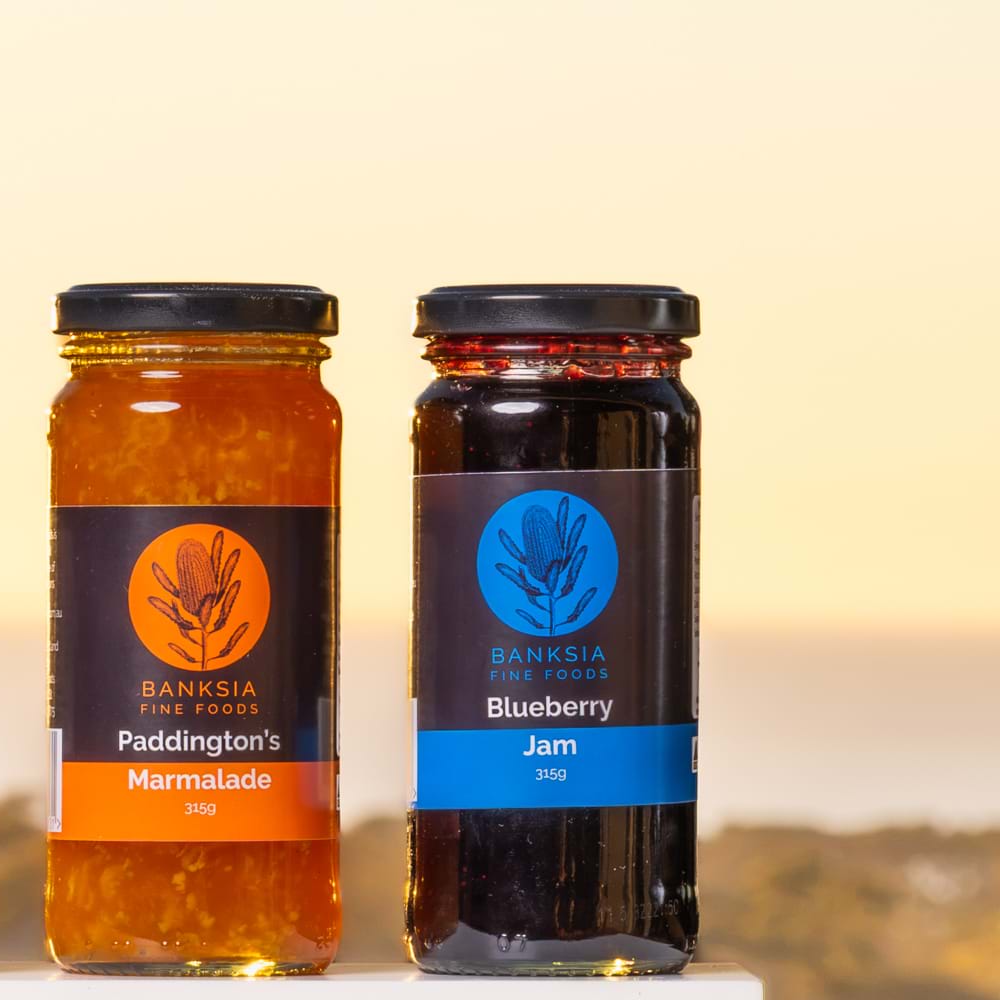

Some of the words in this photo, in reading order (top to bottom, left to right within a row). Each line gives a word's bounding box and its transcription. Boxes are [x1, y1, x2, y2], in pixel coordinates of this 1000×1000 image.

[491, 645, 606, 664] BANKSIA
[490, 669, 533, 680] FINE
[544, 667, 609, 679] FOODS
[142, 680, 256, 697] BANKSIA
[140, 703, 184, 714] FINE
[195, 703, 259, 714] FOODS
[487, 695, 614, 721] Blueberry
[118, 728, 281, 757] Paddington's
[523, 734, 577, 756] Jam
[127, 767, 272, 790] Marmalade
[535, 768, 567, 781] 315g
[184, 802, 217, 816] 315g
